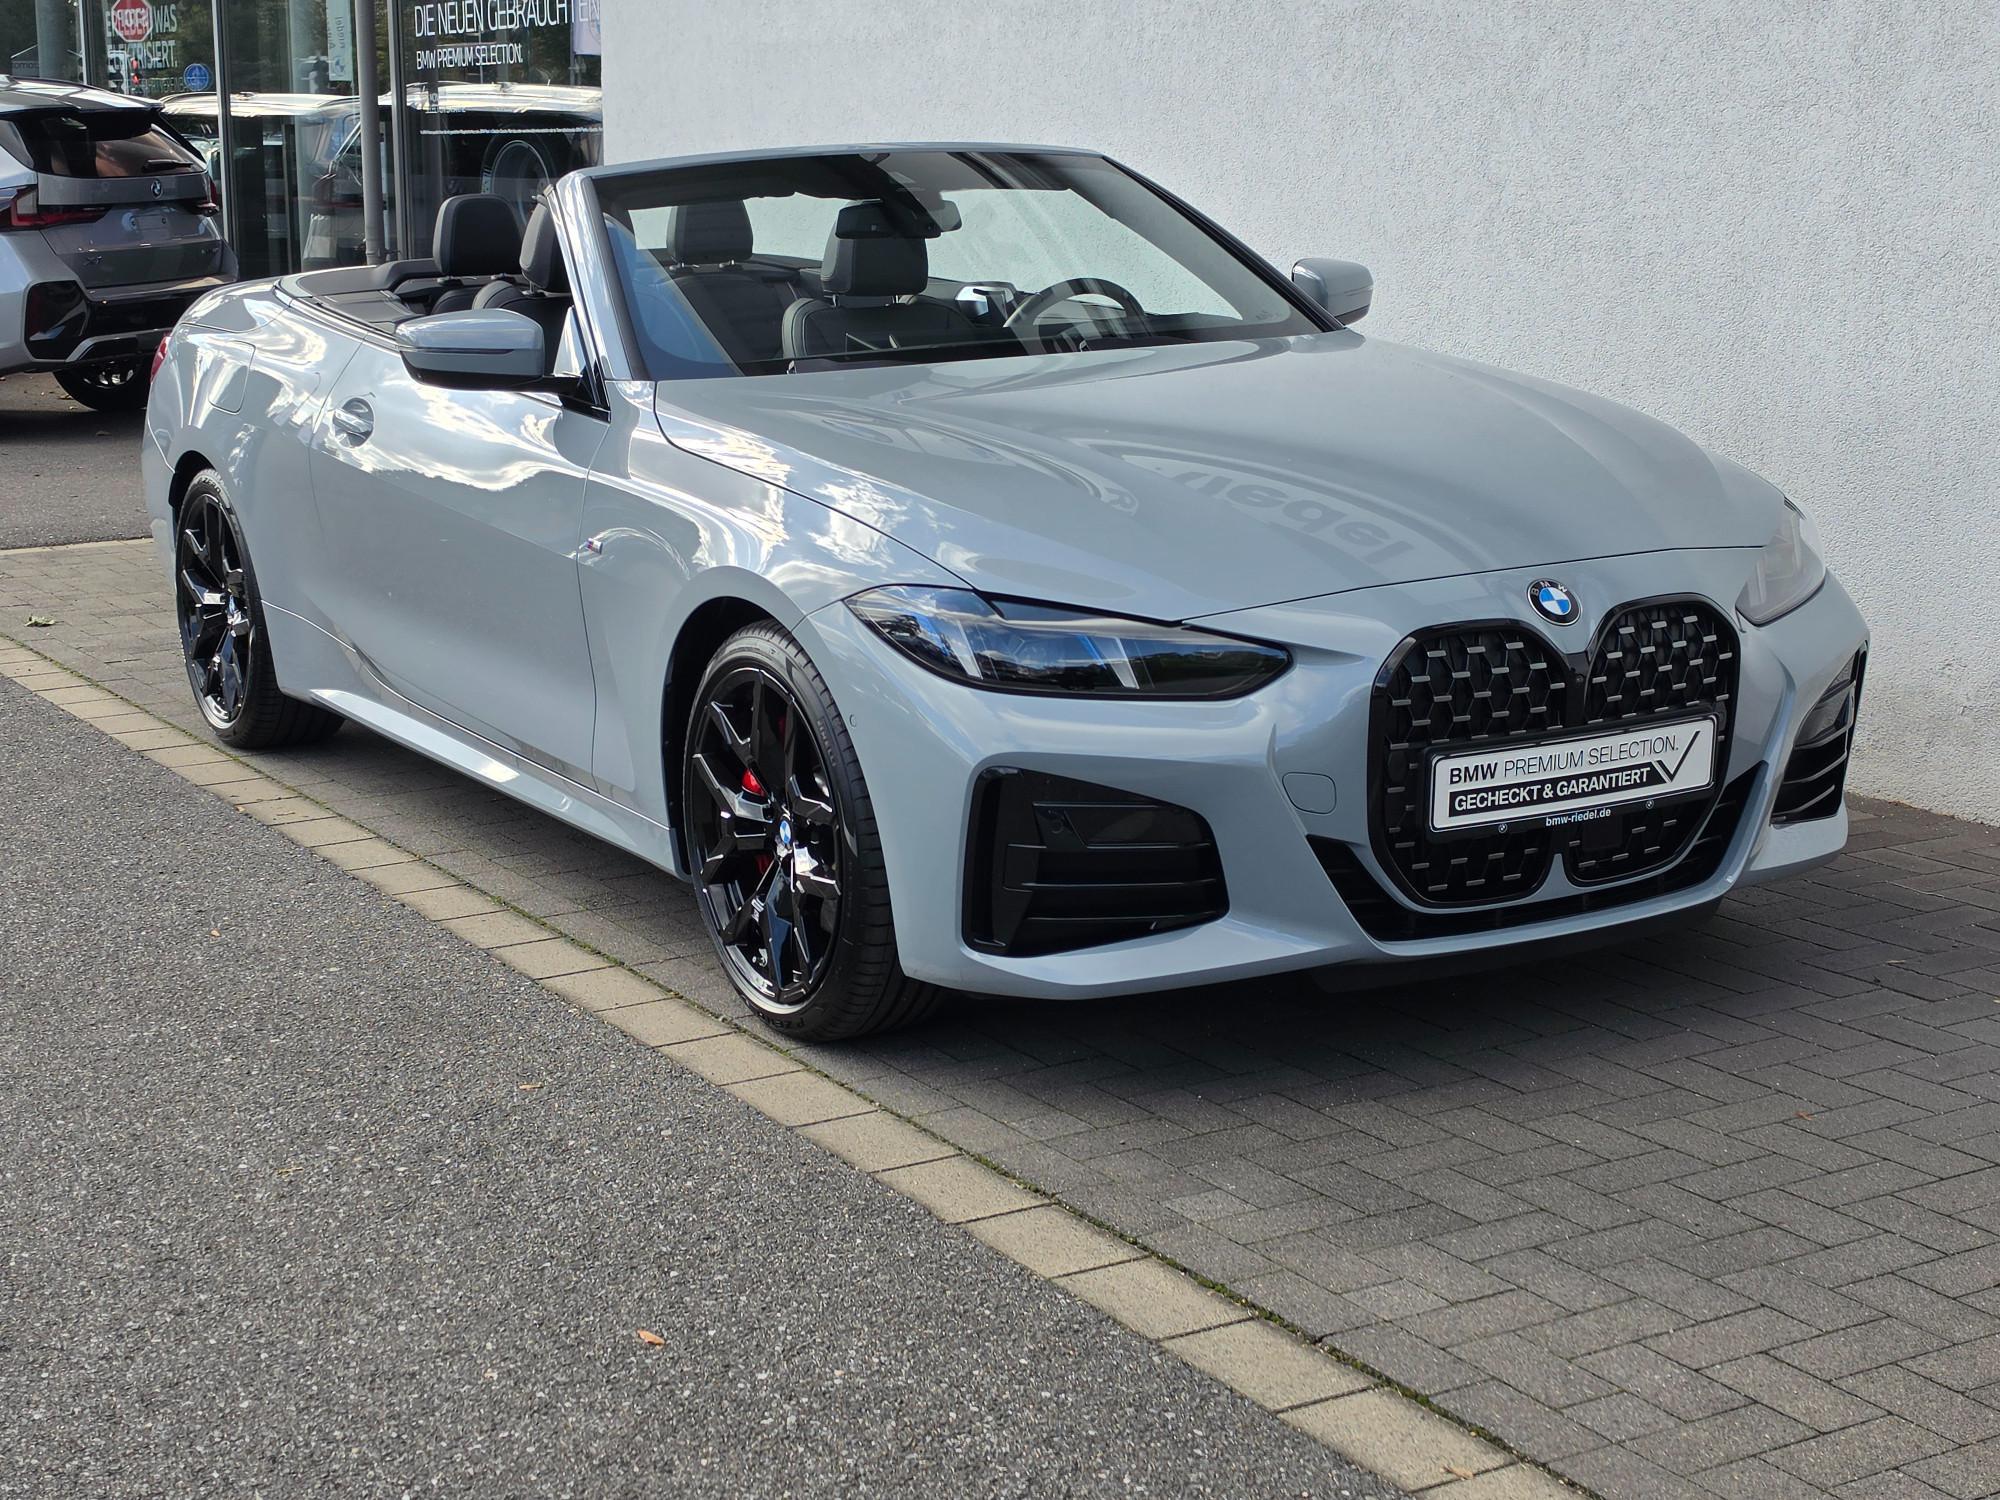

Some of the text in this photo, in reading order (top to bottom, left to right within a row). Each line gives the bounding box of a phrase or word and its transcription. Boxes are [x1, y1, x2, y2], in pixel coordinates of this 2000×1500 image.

[153, 4, 177, 33] WAS
[415, 5, 435, 37] DIE
[438, 0, 484, 34] NEUEN
[417, 50, 436, 70] BMW
[438, 47, 474, 68] PREMIUM
[1531, 581, 1568, 597] BMW
[1450, 735, 1679, 785] BMW PREMIUM SELECTION.
[1454, 767, 1650, 811] GECHECKT & GARANTIERT
[1545, 808, 1611, 827] bmw-riedel.de
